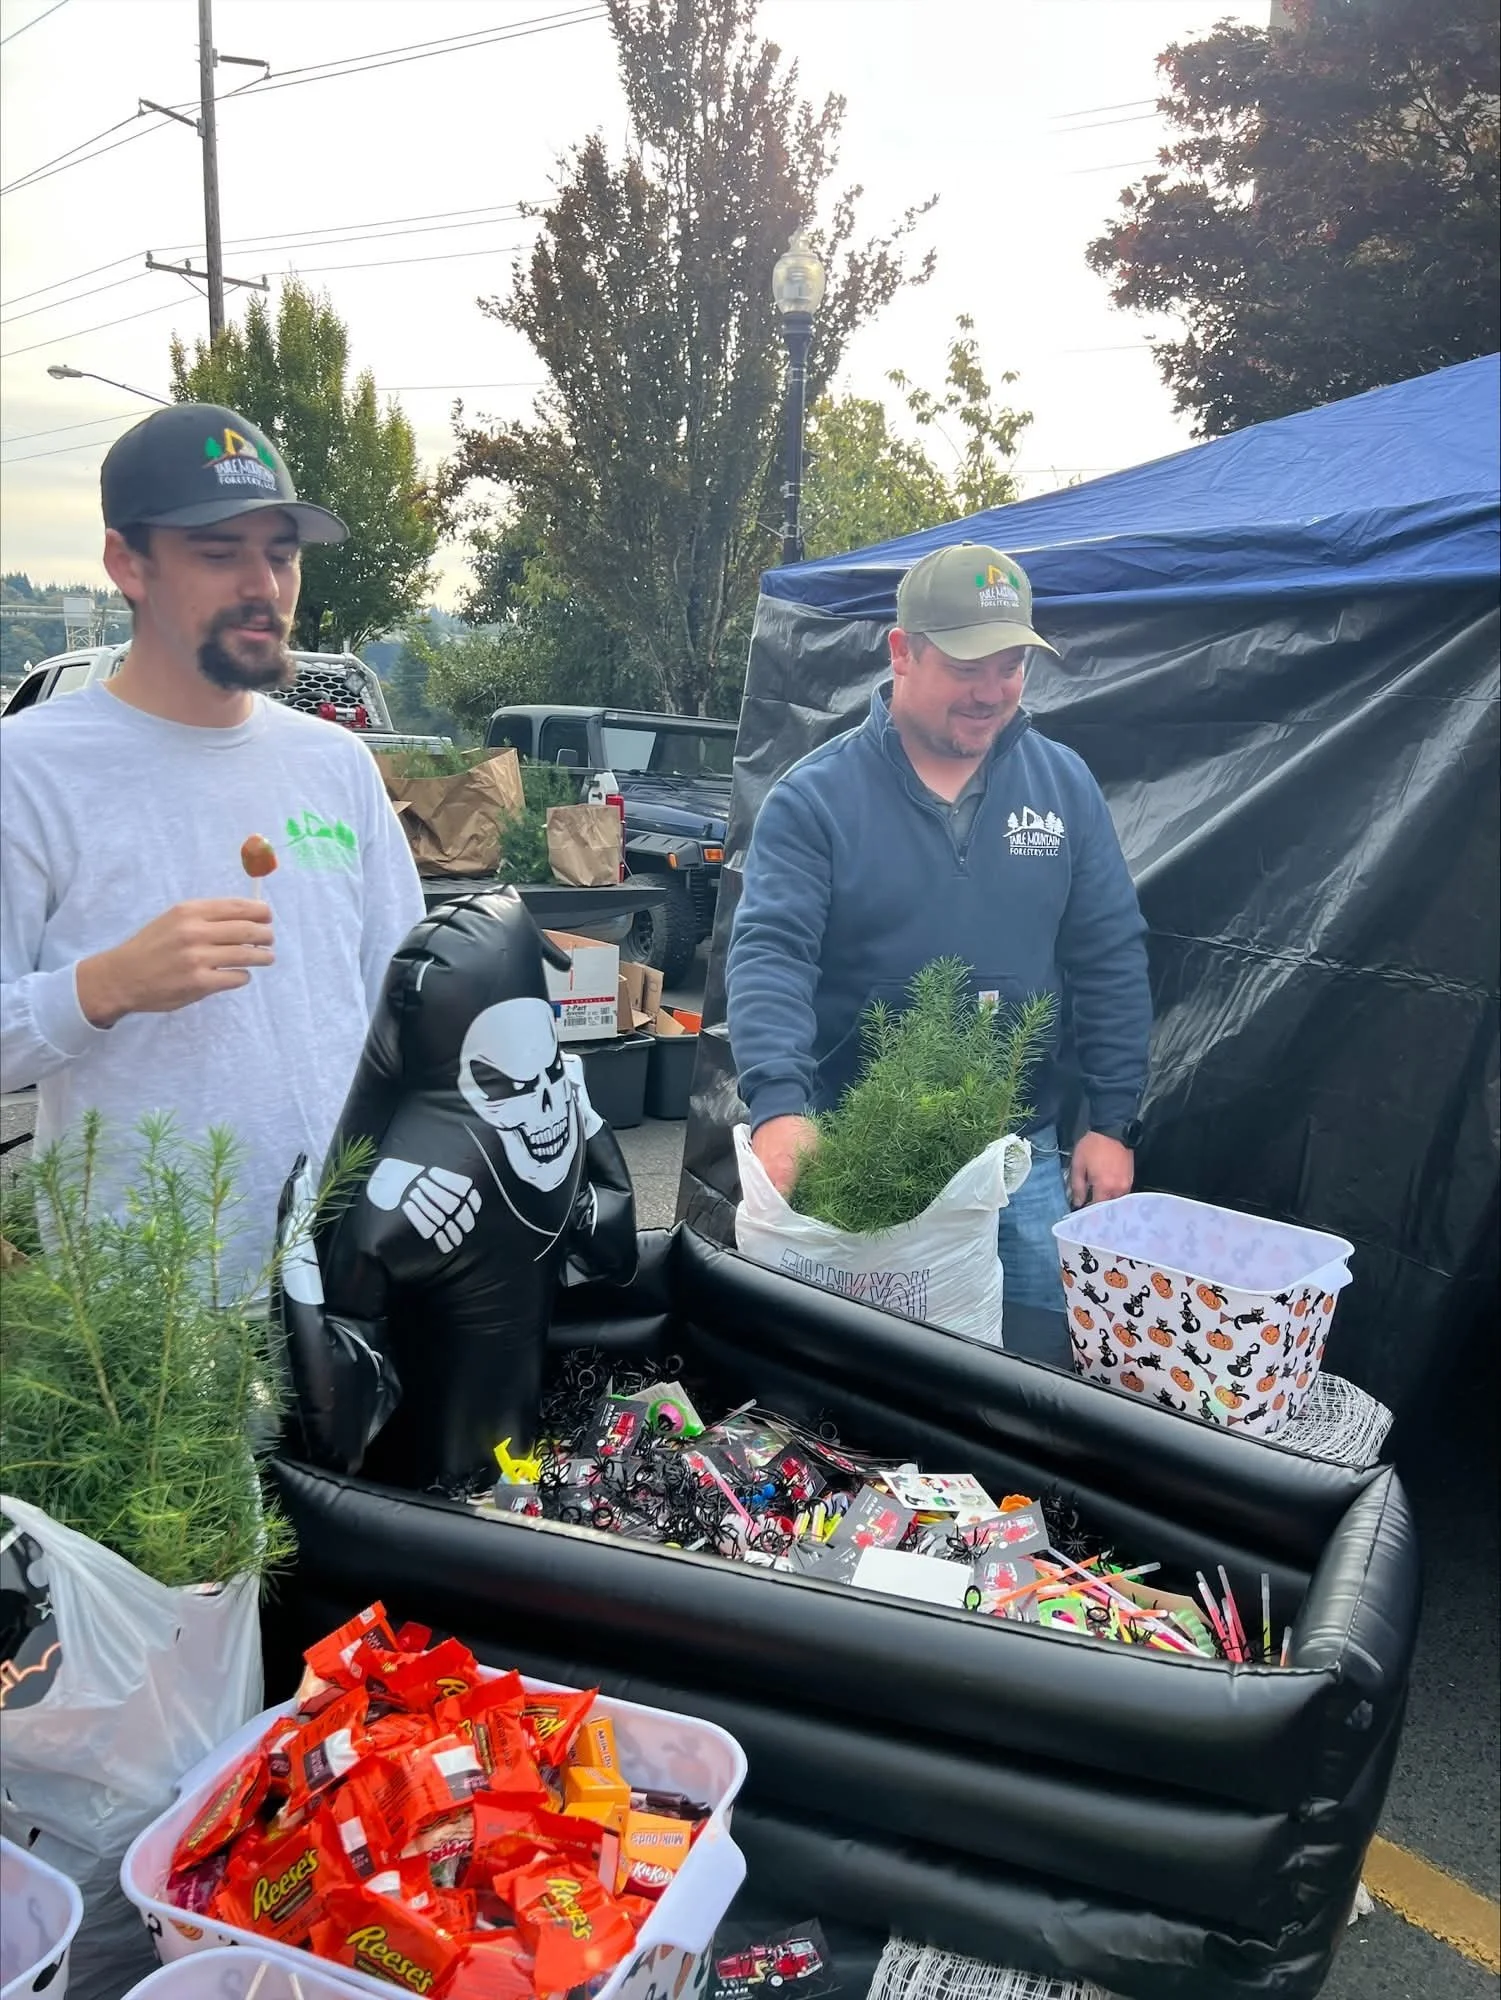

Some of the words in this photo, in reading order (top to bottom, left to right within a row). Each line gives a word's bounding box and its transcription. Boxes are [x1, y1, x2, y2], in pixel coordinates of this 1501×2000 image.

[1046, 848, 1059, 857] LLC
[252, 1848, 319, 1922] Reese's
[345, 1925, 434, 1994] Reese's
